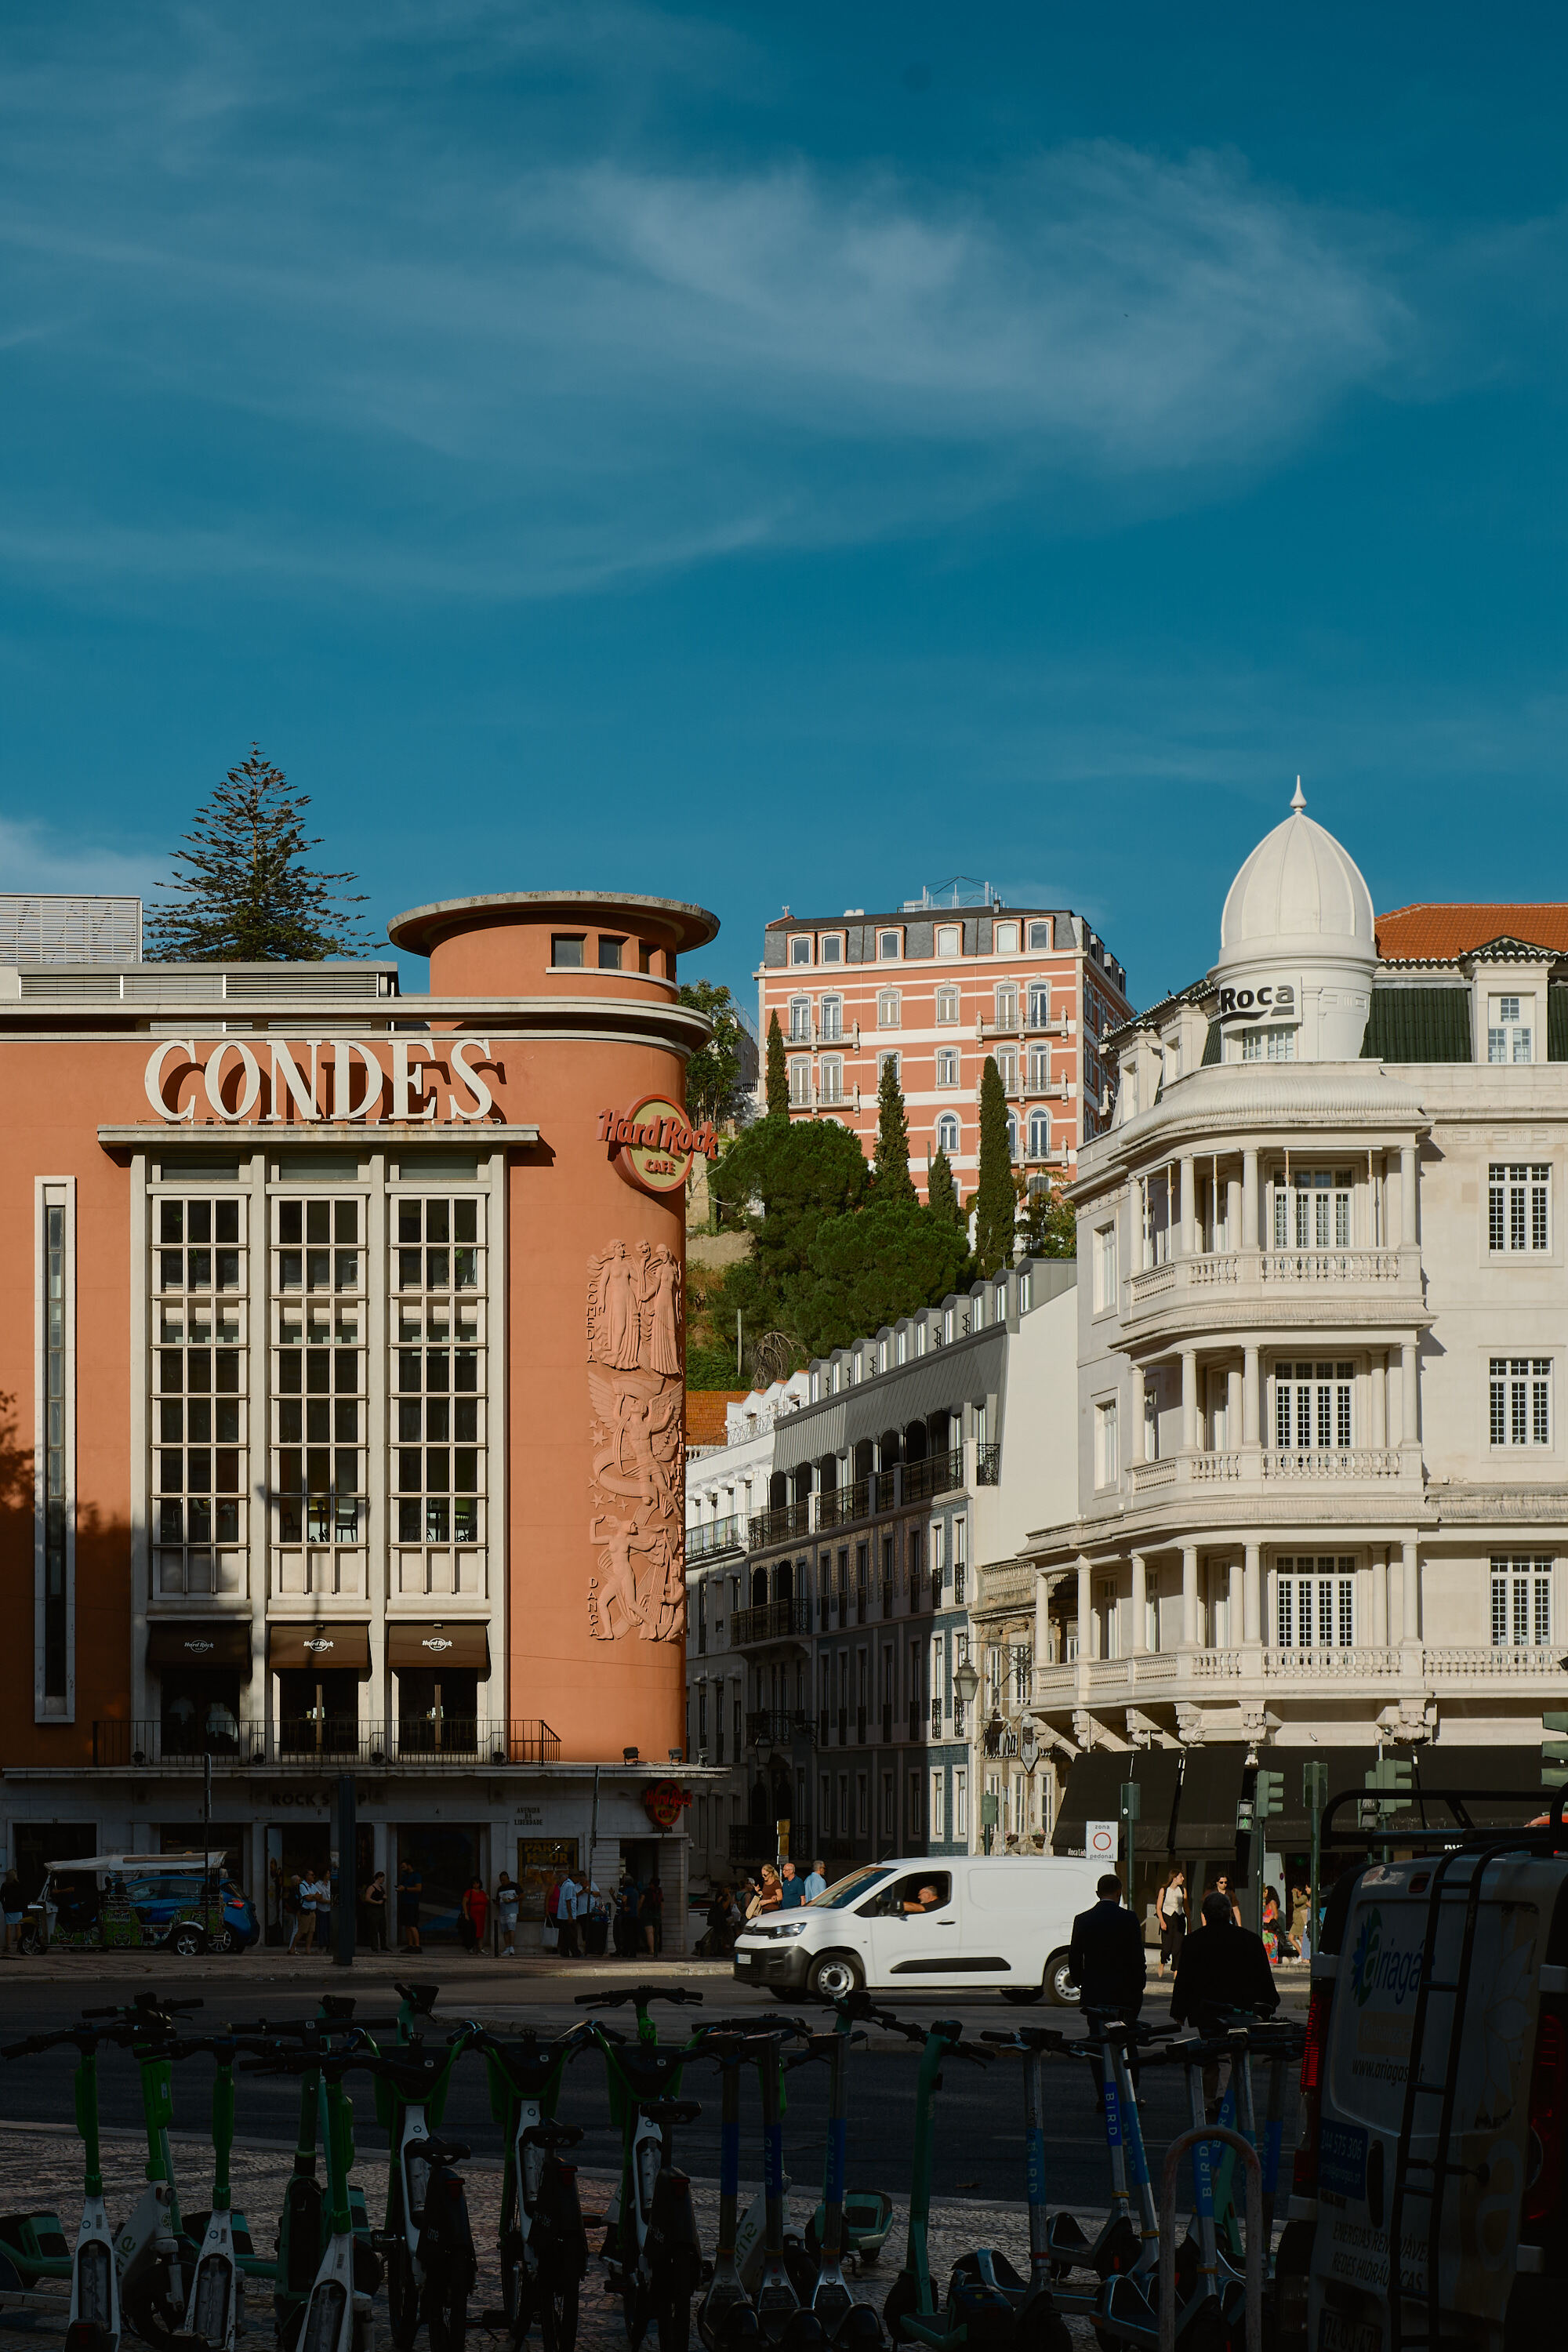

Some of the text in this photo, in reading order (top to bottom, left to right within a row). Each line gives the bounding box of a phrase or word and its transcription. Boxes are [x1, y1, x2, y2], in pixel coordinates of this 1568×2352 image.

[1221, 985, 1294, 1012] Roca
[144, 1039, 492, 1120] CONDES
[597, 1109, 719, 1160] Hard Rock
[644, 1159, 676, 1174] CAFE
[272, 1794, 367, 1806] ROCK SP
[1105, 2092, 1117, 2136] BIRD
[1212, 2103, 1229, 2148] BRD
[1027, 2142, 1038, 2194] BIRD
[1200, 2146, 1212, 2198] BIRD
[1332, 2220, 1371, 2249] ENERGIAS
[1331, 2251, 1356, 2277] REDES
